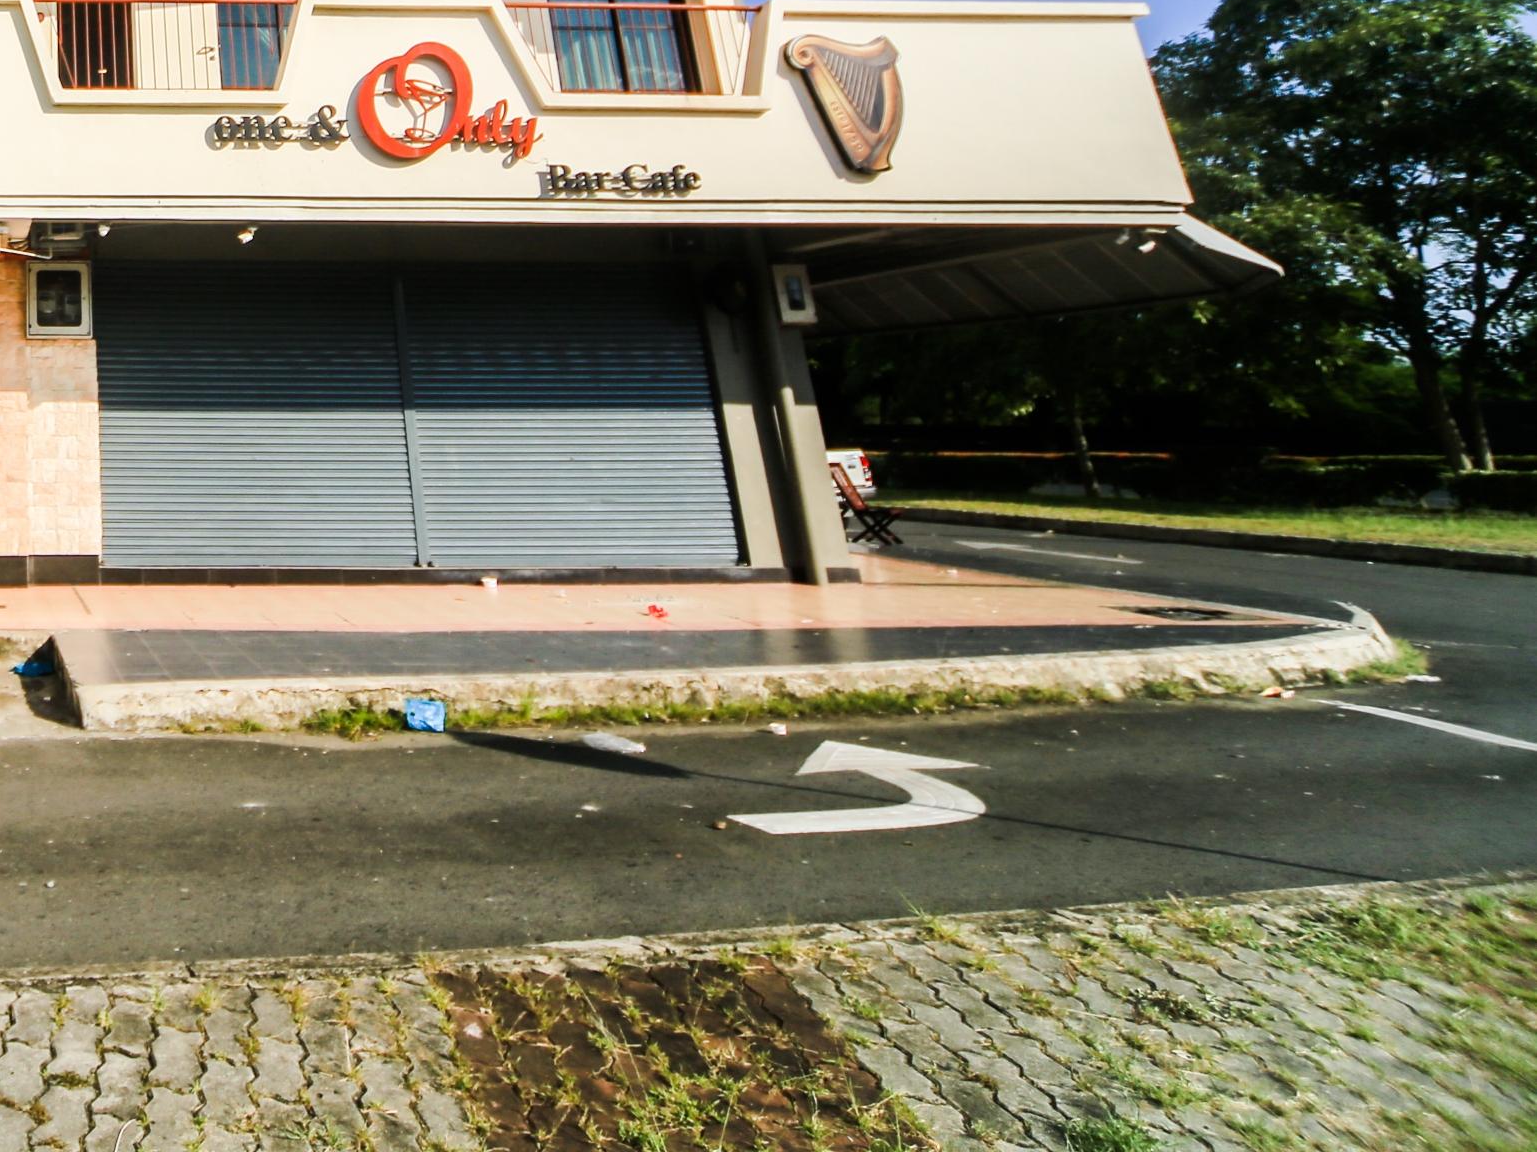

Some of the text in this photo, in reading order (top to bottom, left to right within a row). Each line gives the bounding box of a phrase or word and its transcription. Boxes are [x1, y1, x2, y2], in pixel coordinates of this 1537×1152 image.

[214, 41, 543, 159] one & Only
